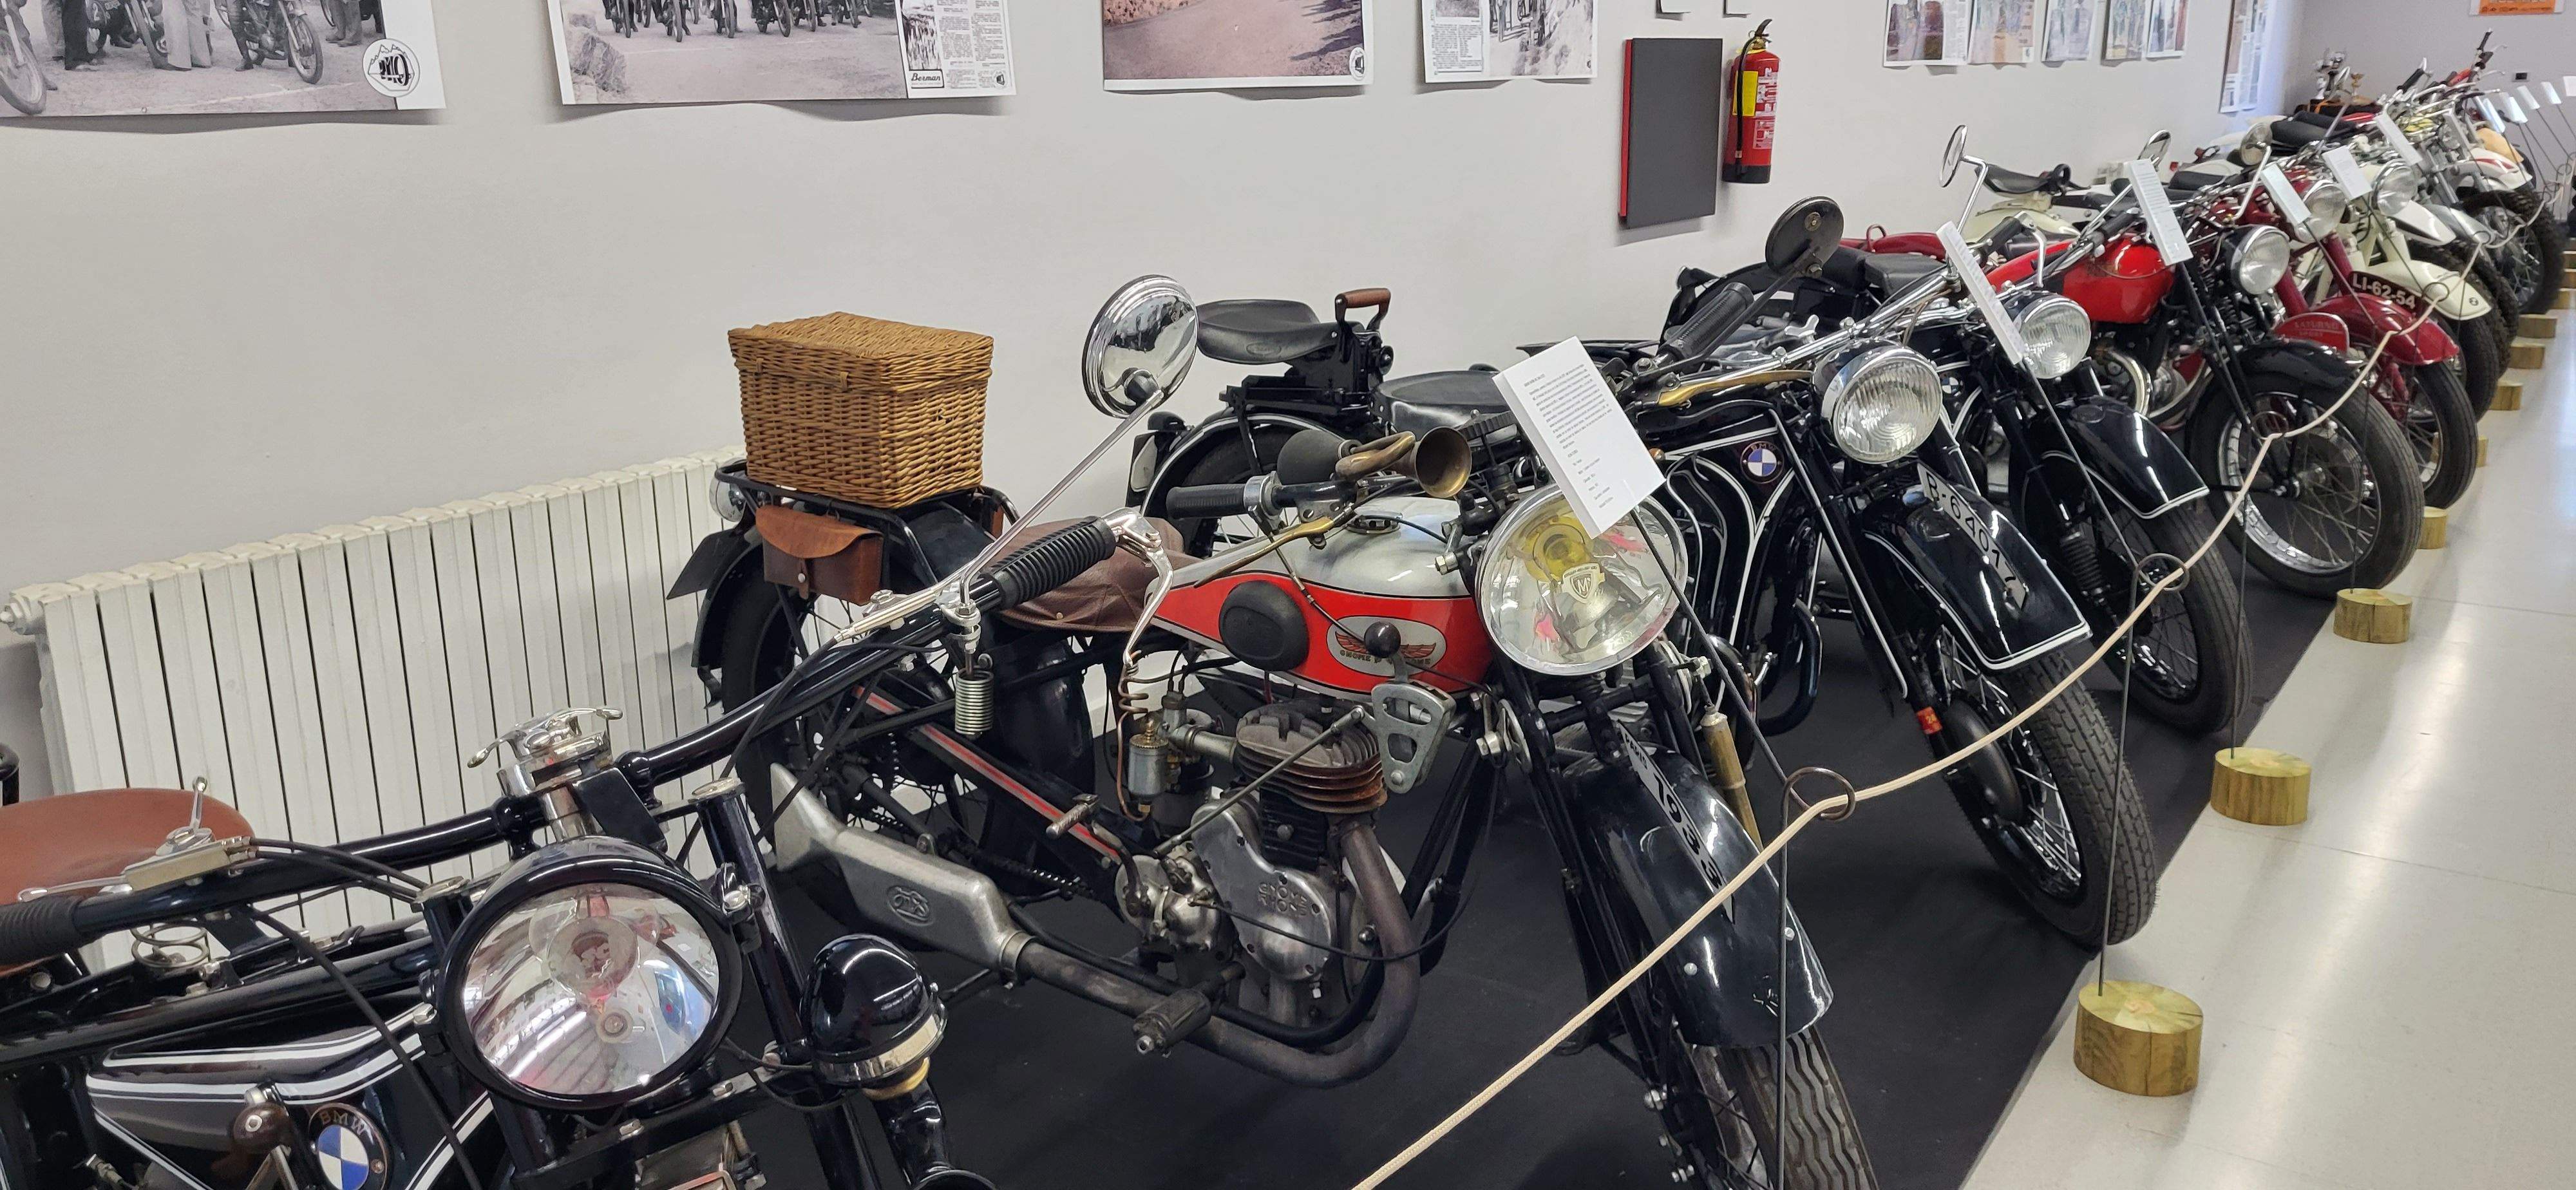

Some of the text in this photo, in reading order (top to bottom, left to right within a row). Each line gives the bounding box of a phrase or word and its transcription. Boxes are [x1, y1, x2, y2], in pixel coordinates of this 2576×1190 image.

[911, 73, 941, 81] Berman
[2352, 273, 2416, 310] LI-62-54
[1750, 442, 1776, 451] BMW
[1926, 471, 2016, 582] B-64017
[319, 1110, 368, 1135] BMW
